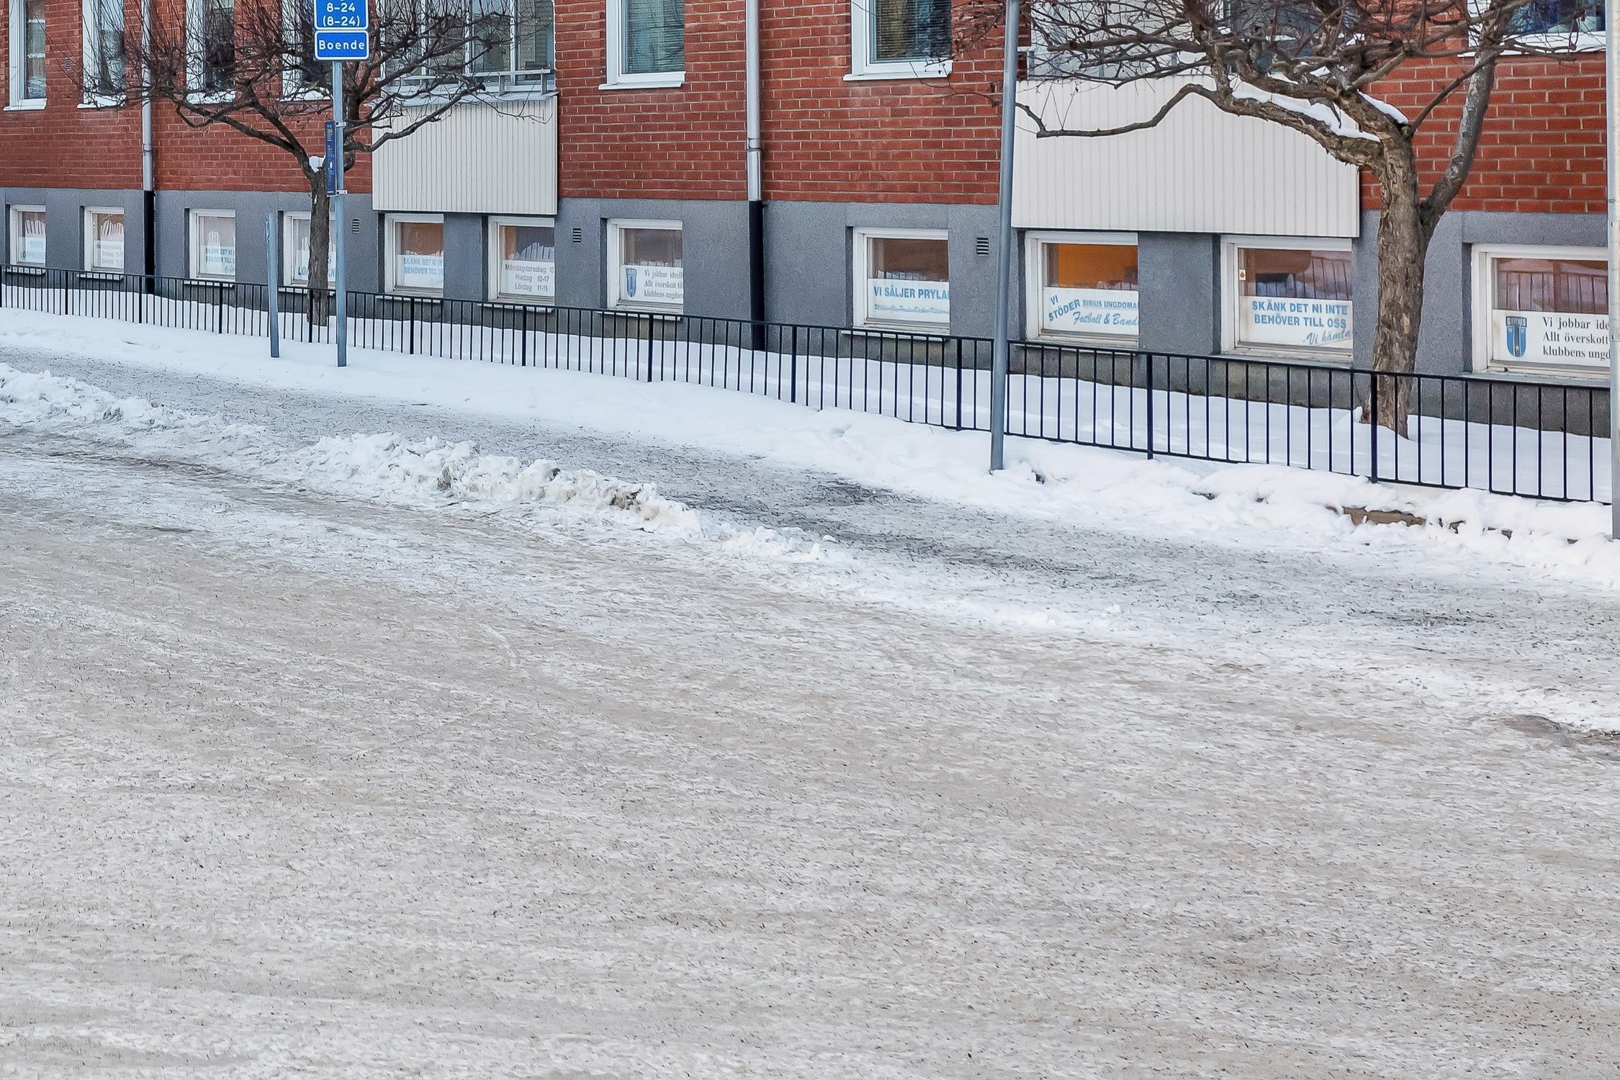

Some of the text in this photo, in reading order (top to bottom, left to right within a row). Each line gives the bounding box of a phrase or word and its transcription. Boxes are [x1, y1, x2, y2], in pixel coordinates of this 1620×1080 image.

[326, 2, 356, 13] 8-24
[321, 15, 361, 27] (8-24)
[318, 39, 365, 50] Boende
[873, 286, 882, 297] VI
[1050, 295, 1059, 306] VI
[1082, 299, 1103, 308] SIRIUS
[1252, 299, 1348, 316] SKÄNK DET NI INTE
[1048, 298, 1081, 322] STÖDER
[1072, 311, 1101, 326] Fotboll
[1103, 312, 1110, 325] &
[1254, 313, 1347, 329] BEHÖVER TILL OSS
[1542, 316, 1553, 328] Vi
[1557, 317, 1591, 330] jobbar
[1542, 331, 1609, 345] Allt överskott
[1542, 345, 1586, 359] klubbens
